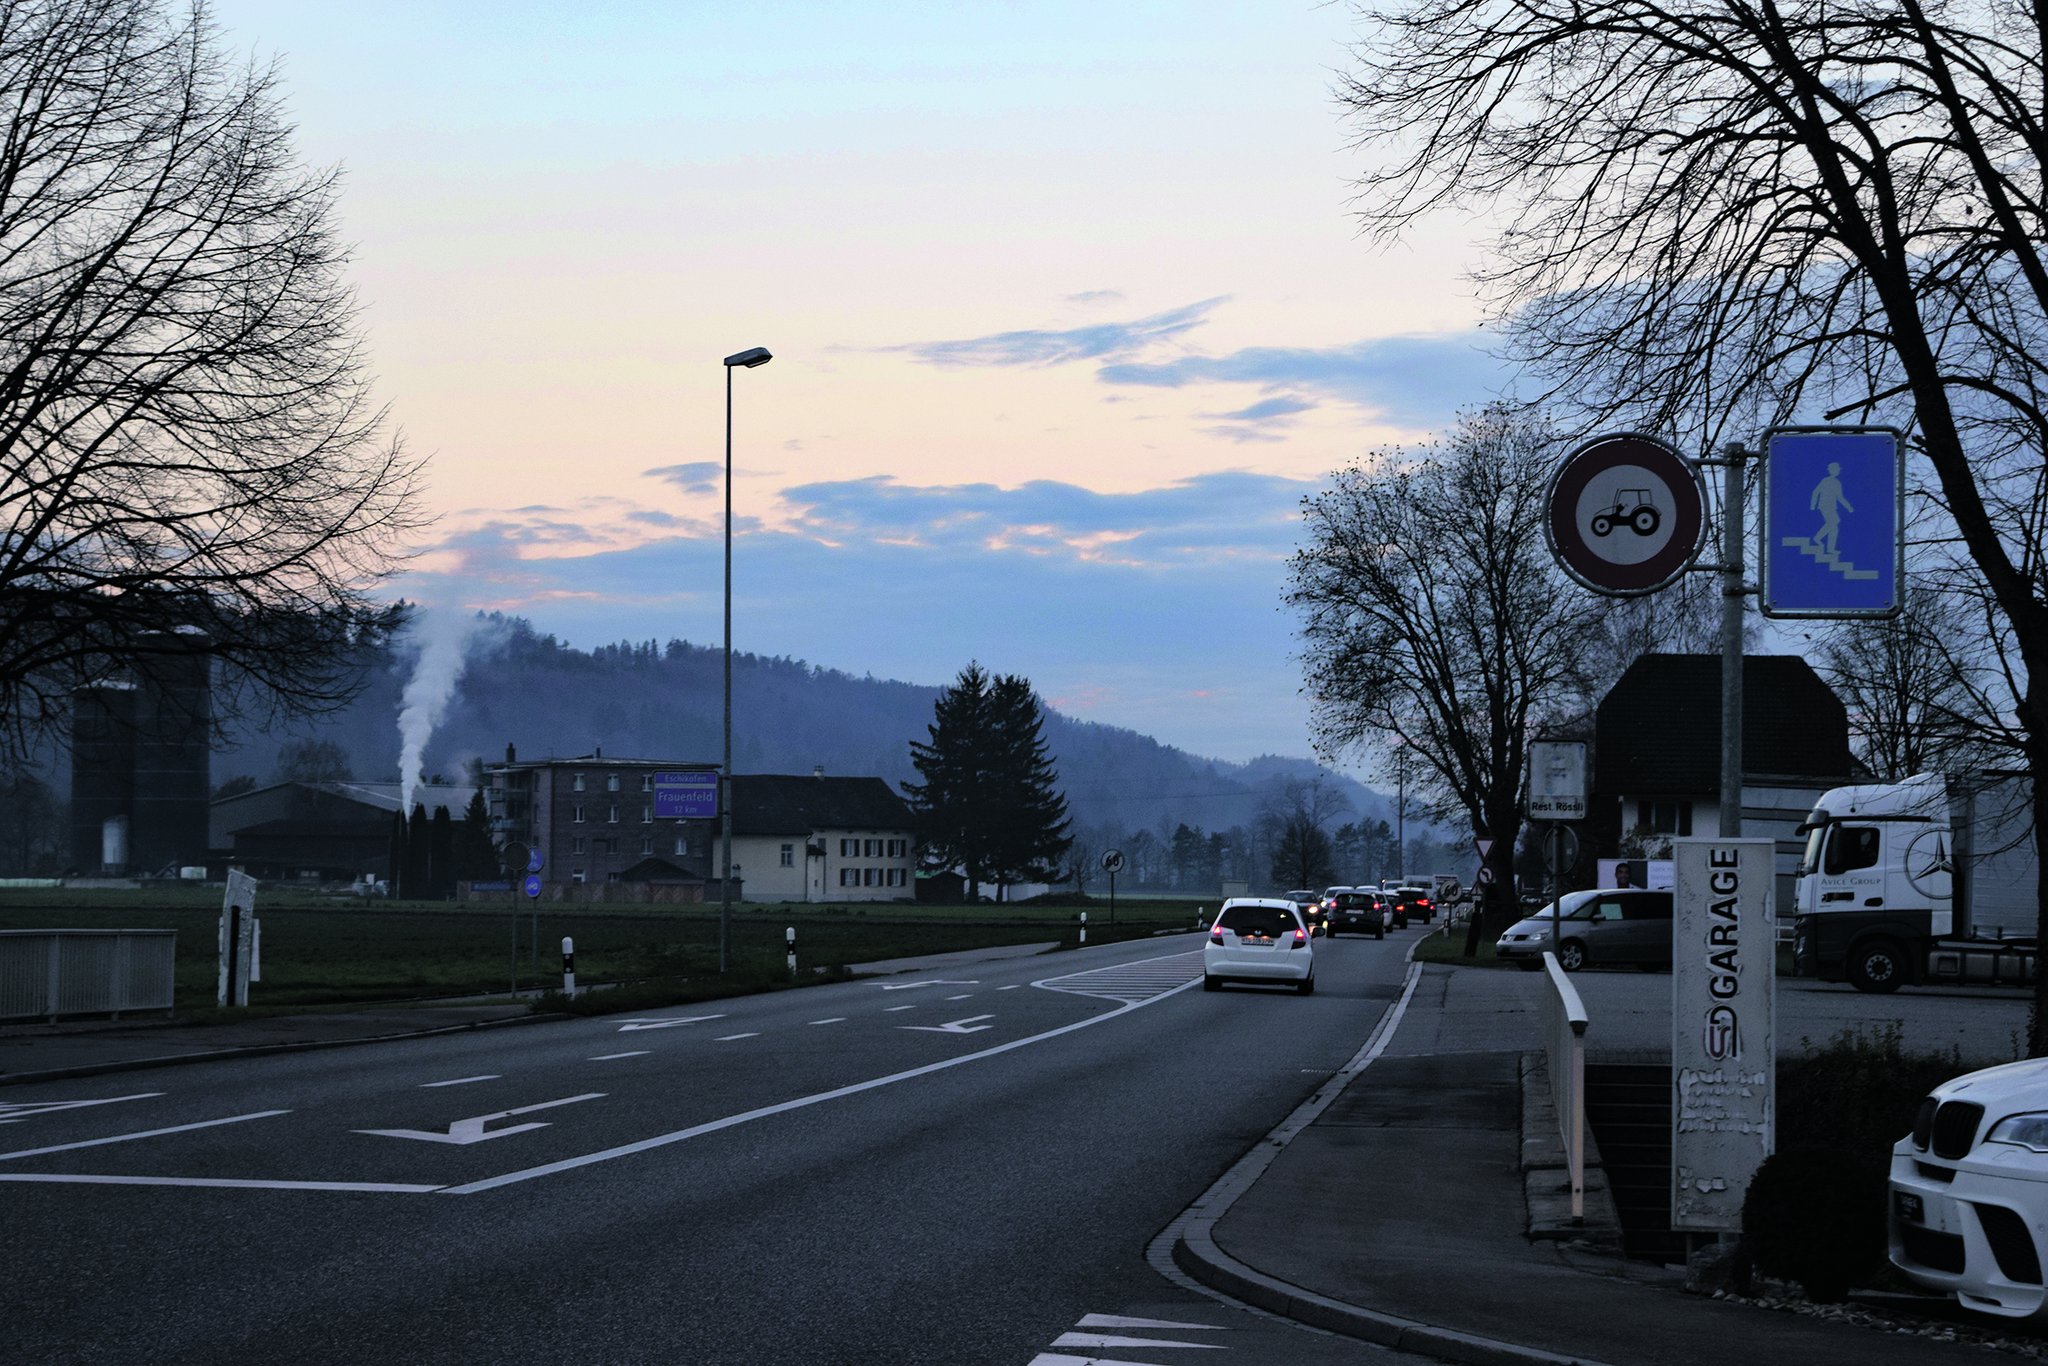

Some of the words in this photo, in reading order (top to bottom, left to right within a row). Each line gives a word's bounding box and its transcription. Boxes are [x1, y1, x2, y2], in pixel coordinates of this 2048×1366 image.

[658, 791, 713, 802] Frauenfeld
[674, 805, 683, 814] 12
[685, 805, 697, 814] km
[1556, 801, 1583, 812] Rössli
[1106, 854, 1119, 866] 60
[1850, 877, 1881, 886] GROUP
[1445, 885, 1458, 896] 60
[1709, 849, 1739, 999] GARAGE
